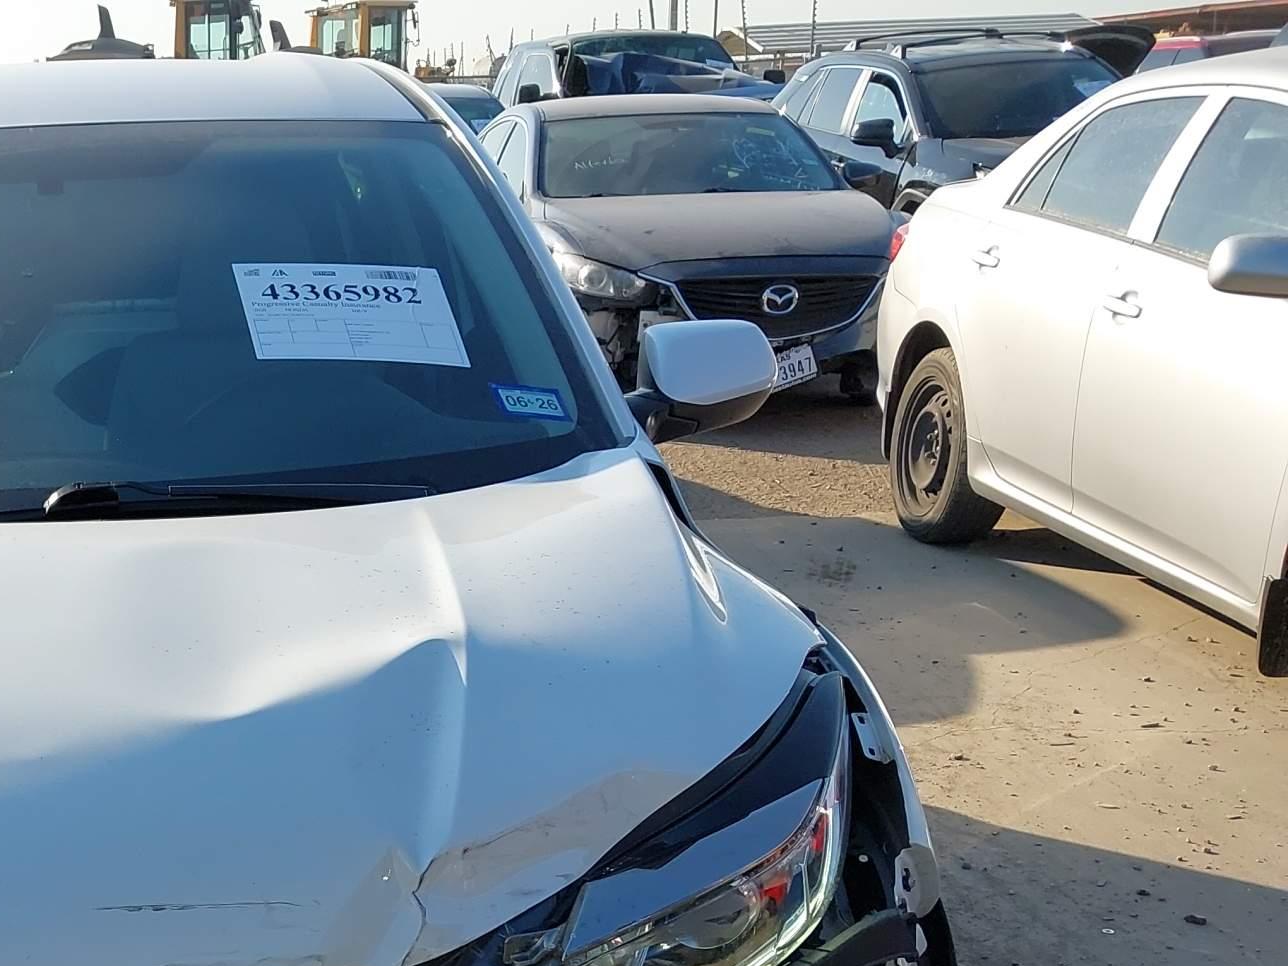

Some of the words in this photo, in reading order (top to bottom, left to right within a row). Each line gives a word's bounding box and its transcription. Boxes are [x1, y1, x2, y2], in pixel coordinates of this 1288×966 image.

[261, 283, 422, 305] 43365982
[779, 356, 812, 381] 3947
[505, 395, 528, 408] 06
[535, 397, 559, 411] 26
